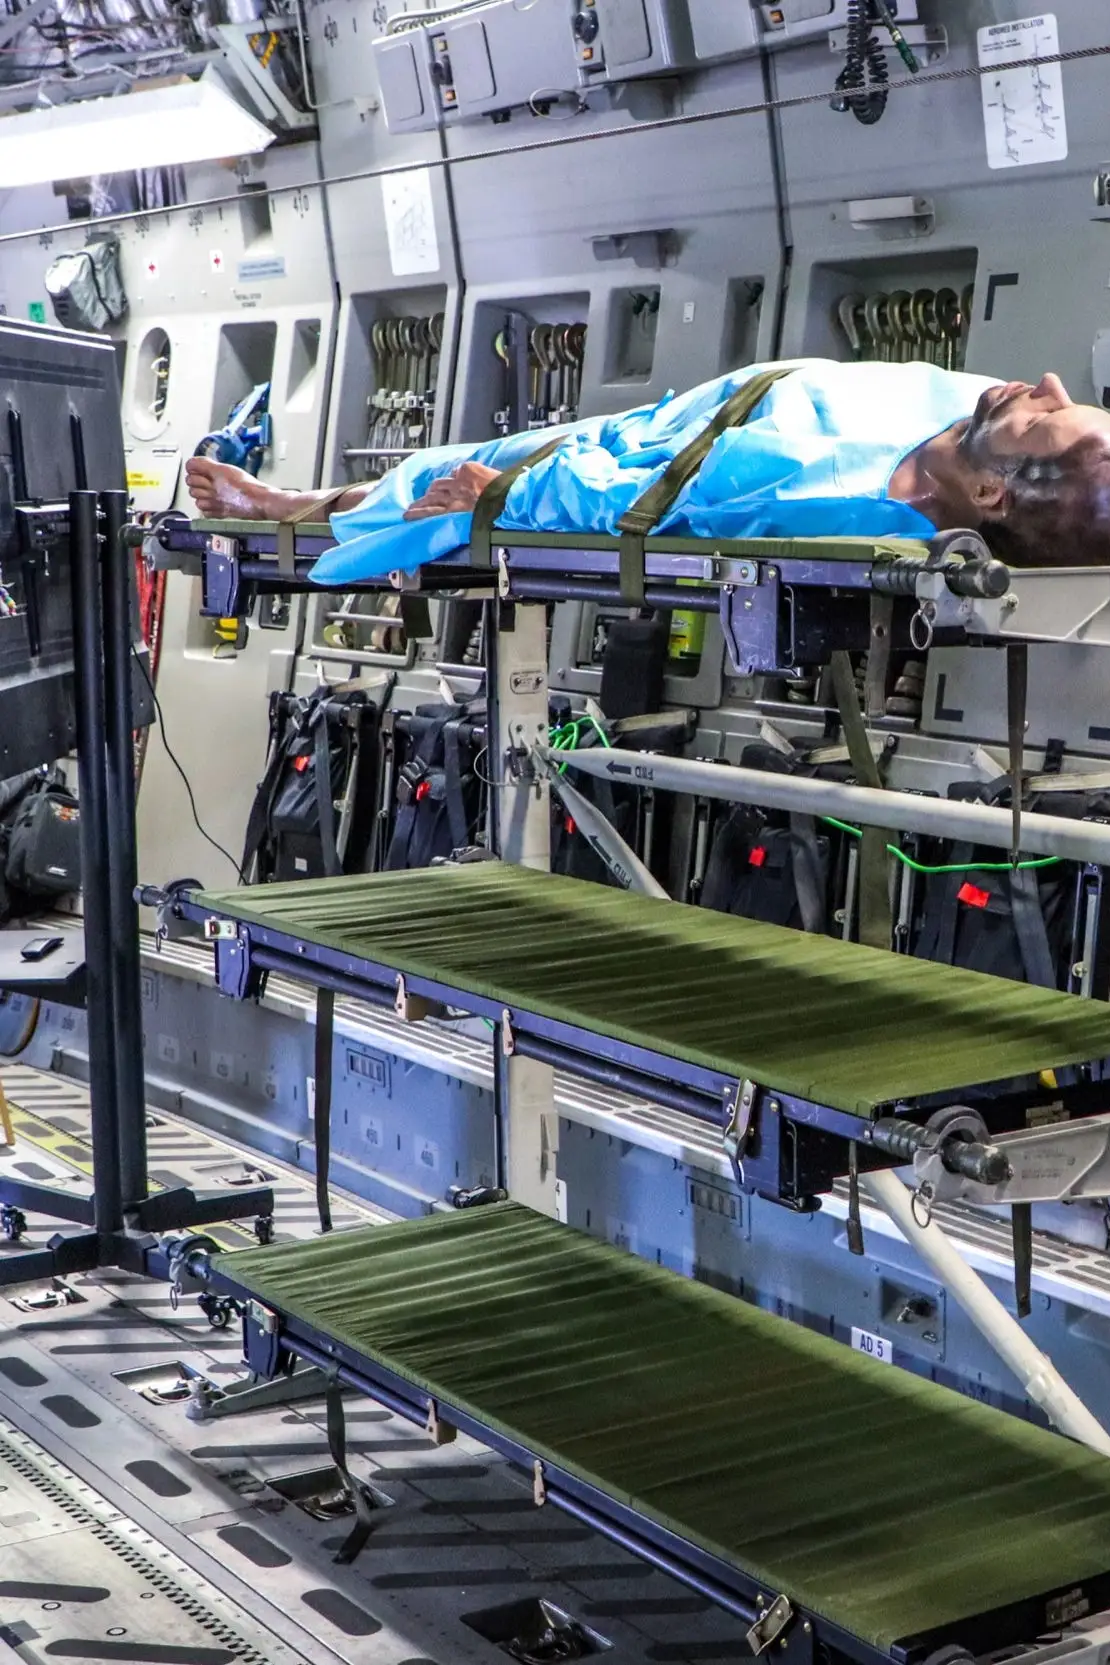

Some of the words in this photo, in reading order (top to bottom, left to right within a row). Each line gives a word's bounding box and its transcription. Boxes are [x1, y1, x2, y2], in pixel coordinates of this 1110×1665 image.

[635, 766, 654, 780] FWD
[860, 1334, 874, 1353] AD
[876, 1341, 884, 1358] 5
